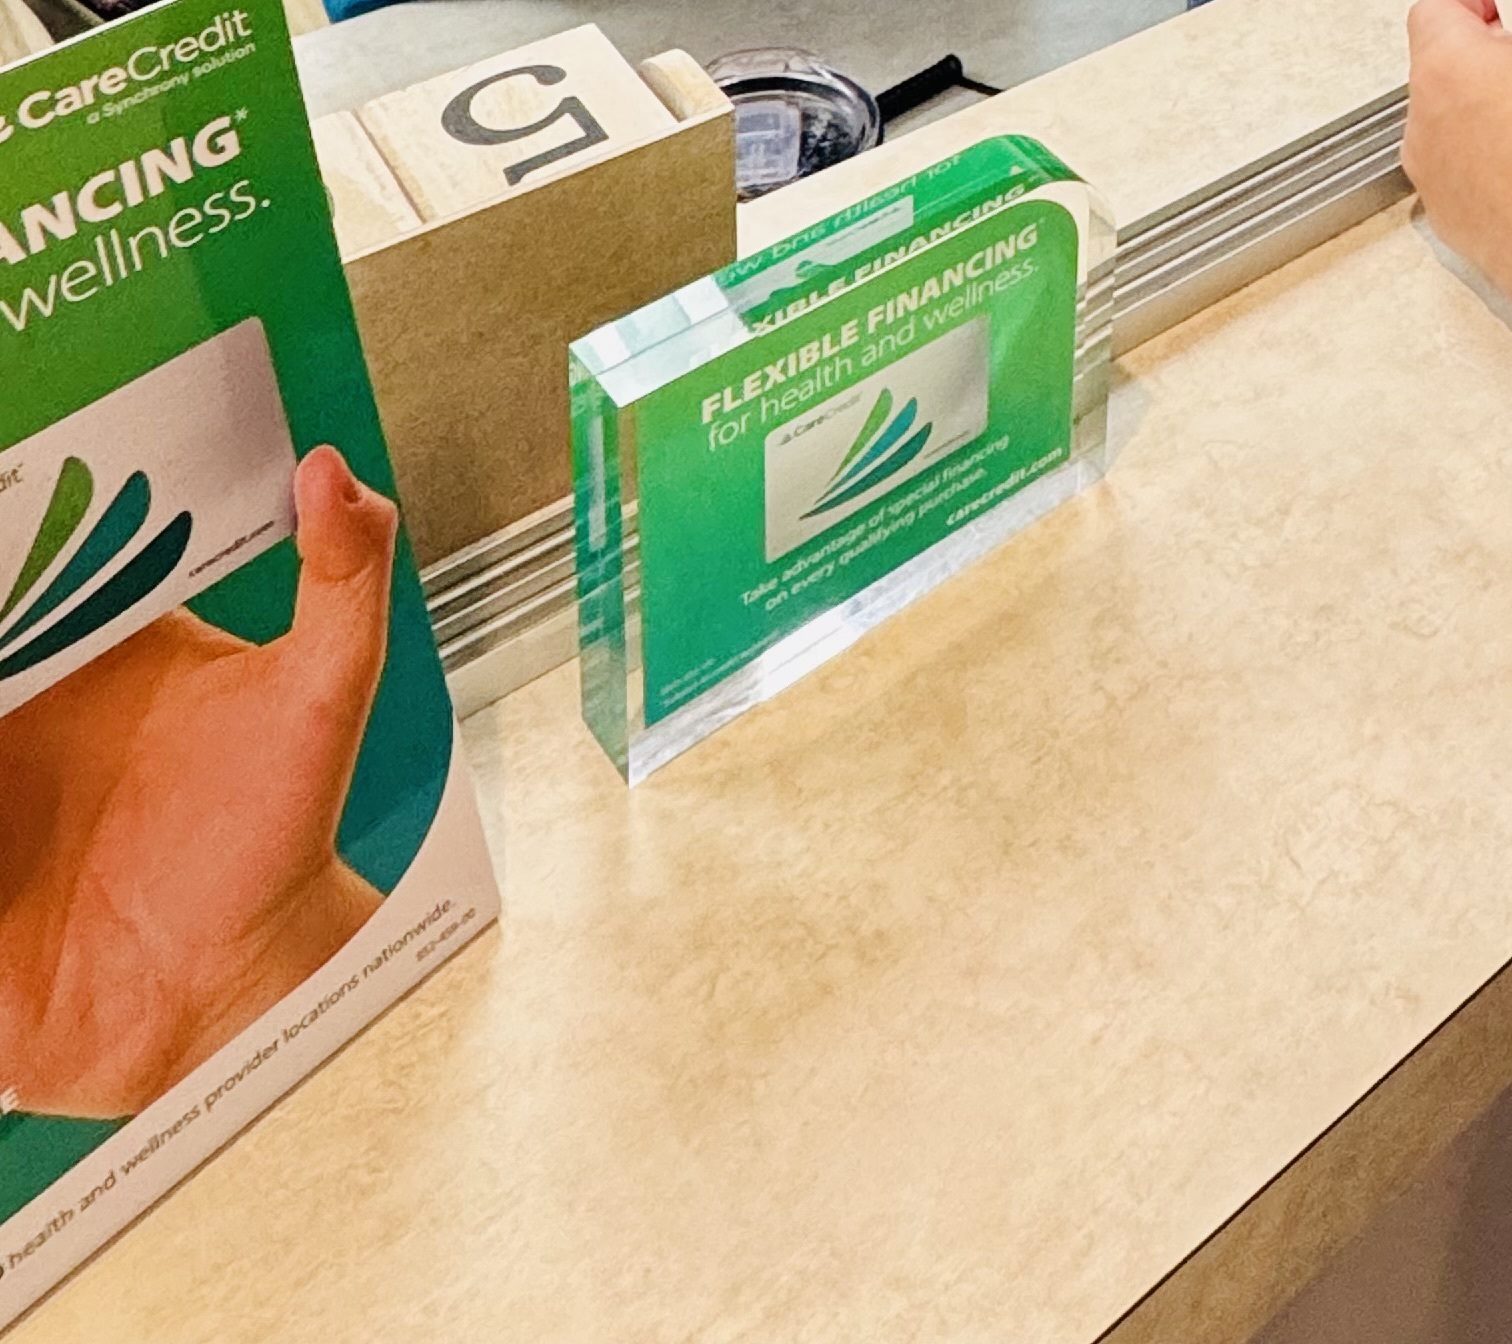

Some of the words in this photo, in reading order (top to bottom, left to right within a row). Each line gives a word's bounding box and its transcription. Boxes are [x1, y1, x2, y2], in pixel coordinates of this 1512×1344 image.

[18, 9, 252, 129] CareCredit
[87, 113, 100, 125] a
[102, 70, 190, 119] Synchrony
[193, 41, 256, 78] solution
[441, 64, 610, 187] 5
[0, 179, 271, 332] wellness.
[701, 318, 859, 424] FLEXIBLE
[707, 411, 758, 453] for
[760, 355, 852, 423] health
[861, 318, 915, 367] and
[922, 256, 1040, 331] wellness.
[740, 574, 779, 606] Take
[781, 519, 867, 583] advantage
[869, 505, 886, 530] of
[887, 472, 941, 516] special
[941, 433, 1011, 486] financing
[946, 445, 1064, 528] carecredit.com
[765, 588, 788, 611] on
[790, 559, 836, 596] every
[838, 508, 918, 569] qualifying
[7, 1209, 75, 1268] health
[79, 1170, 117, 1213] and
[120, 1104, 202, 1176] wellness
[203, 1037, 281, 1113] provider
[282, 973, 360, 1044] locations
